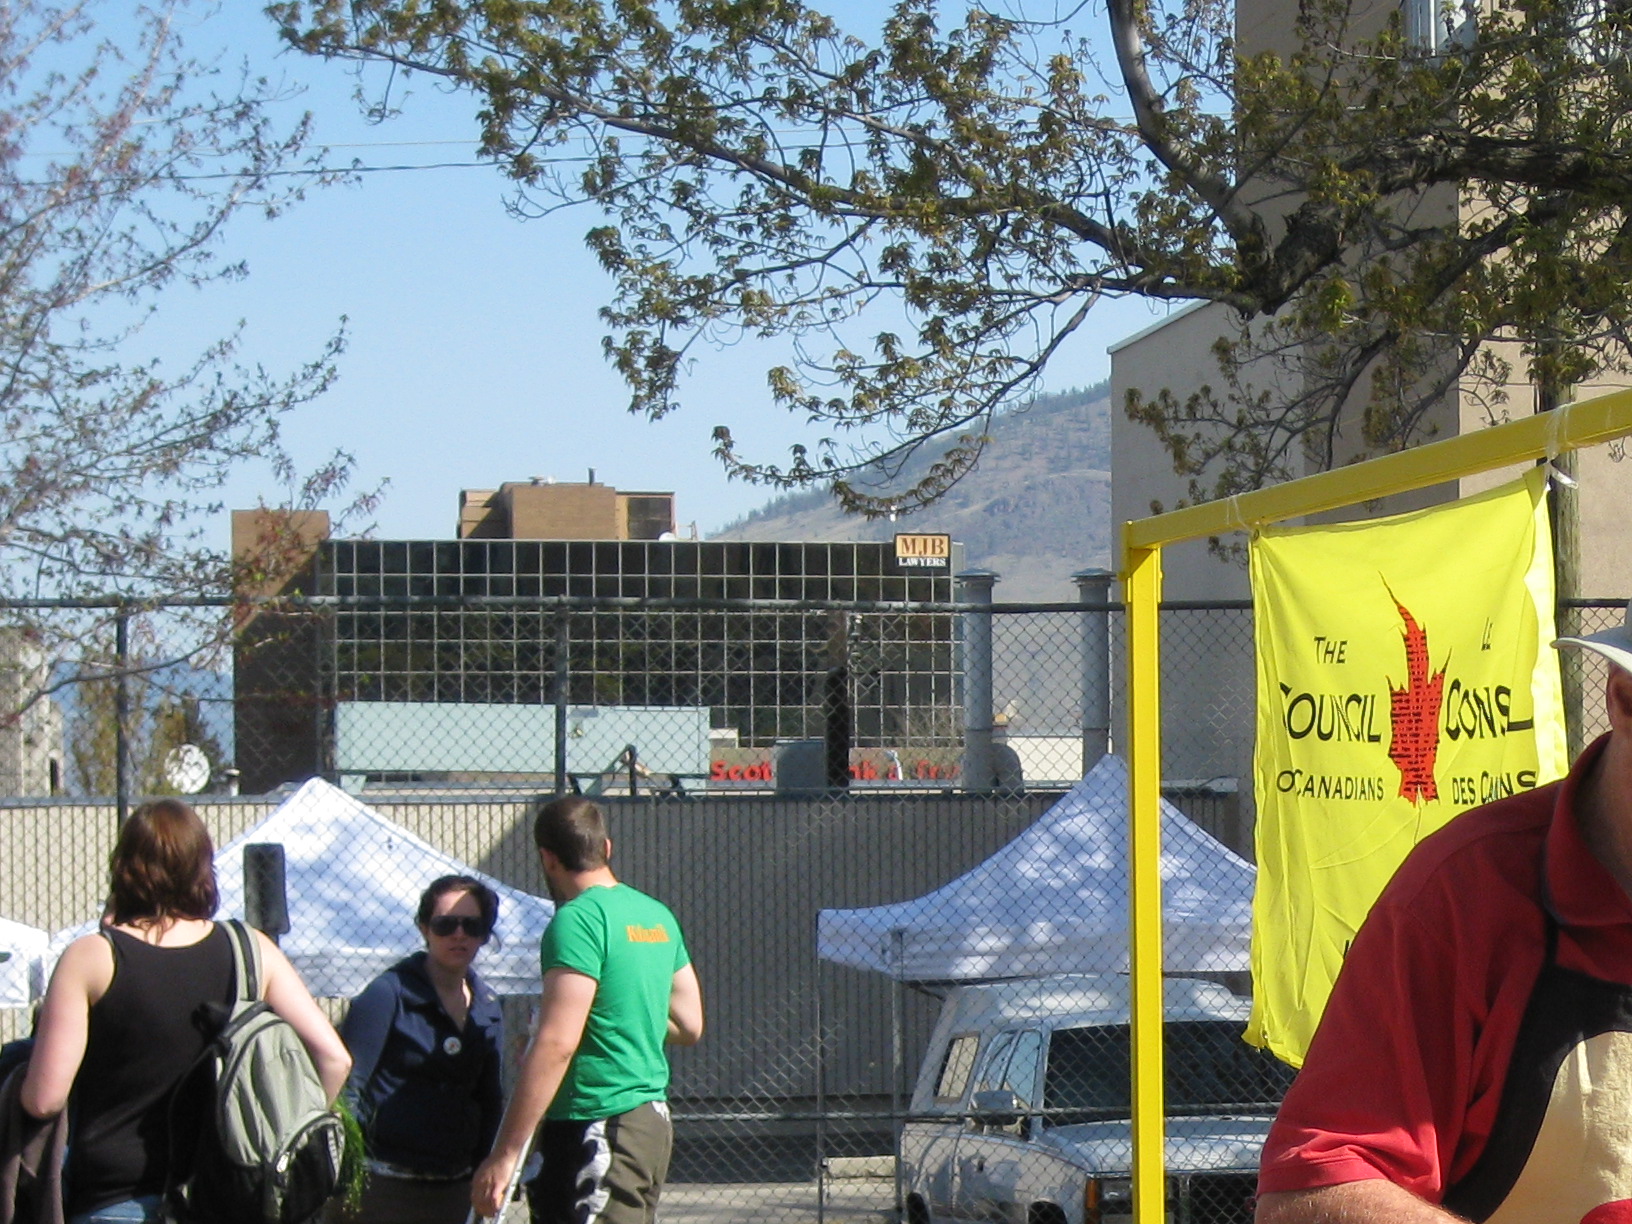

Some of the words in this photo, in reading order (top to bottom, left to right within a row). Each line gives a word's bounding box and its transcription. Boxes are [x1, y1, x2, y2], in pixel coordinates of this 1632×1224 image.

[901, 537, 945, 555] MJB
[899, 557, 947, 567] LAWYERS
[1314, 636, 1347, 664] THE
[1452, 777, 1476, 806] DES
